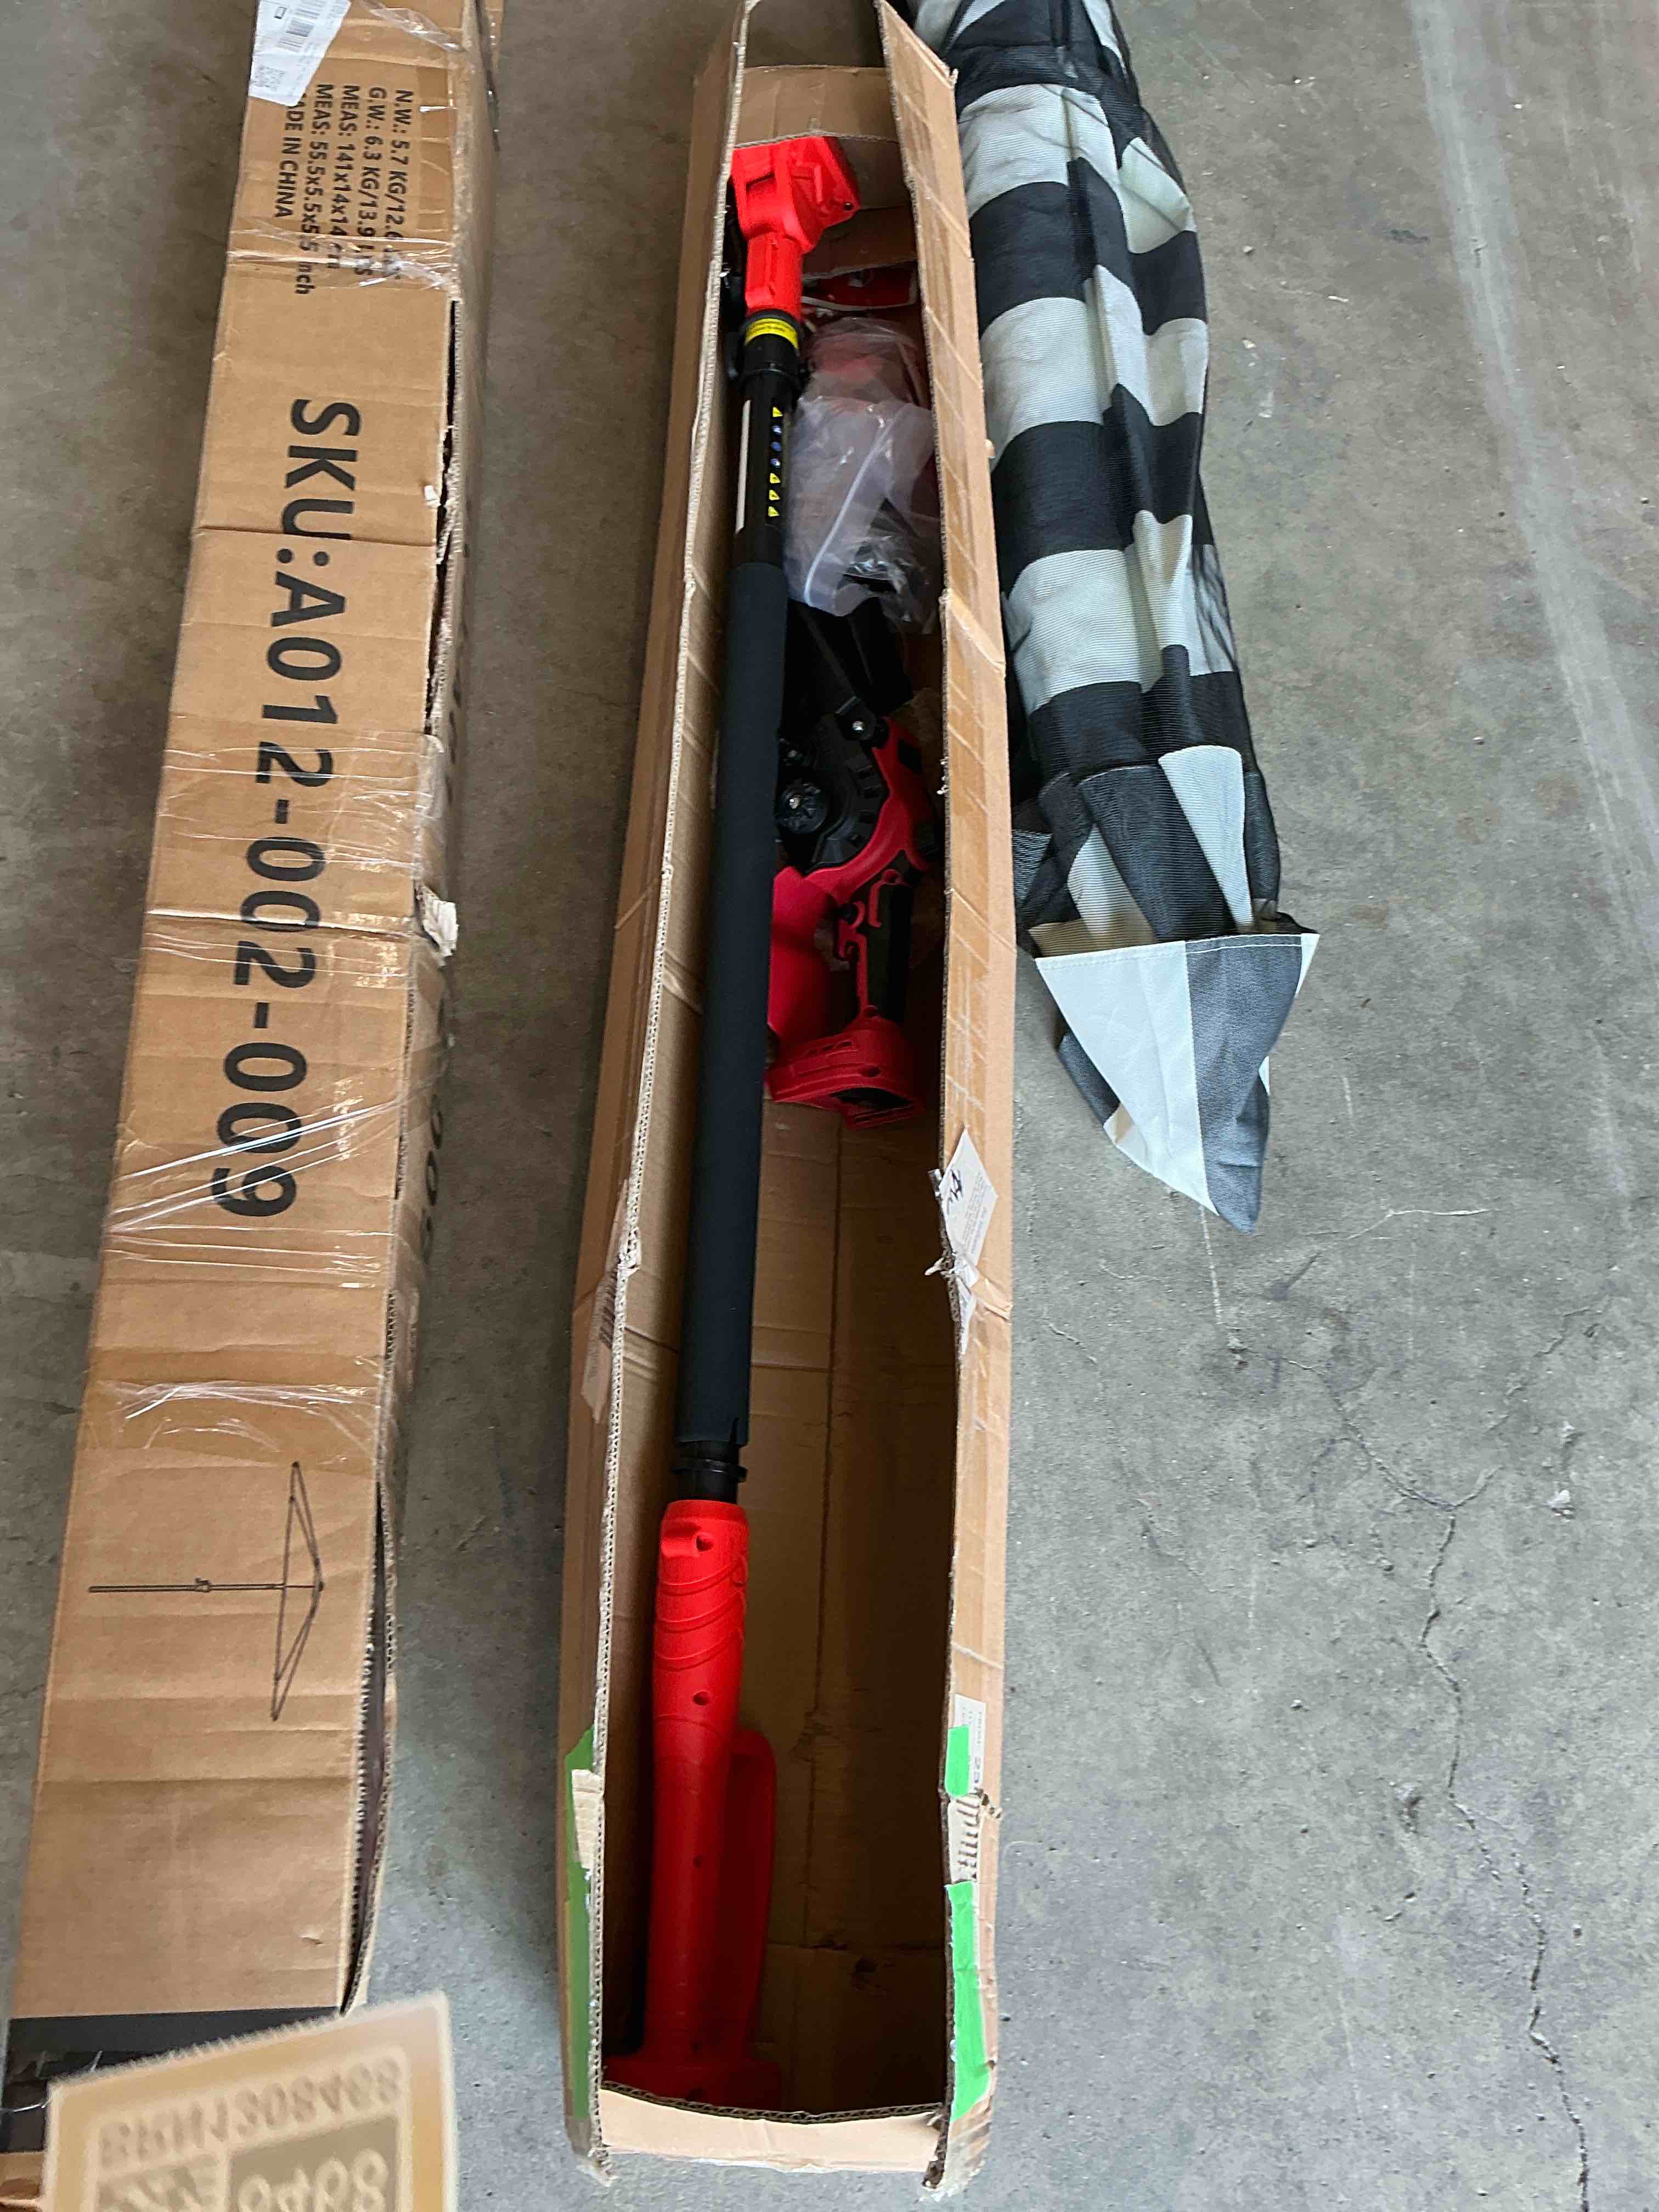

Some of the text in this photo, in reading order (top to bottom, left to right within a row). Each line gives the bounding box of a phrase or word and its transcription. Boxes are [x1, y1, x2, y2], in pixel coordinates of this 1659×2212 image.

[312, 84, 334, 135] MEAS:
[338, 86, 360, 136] MEAS:
[366, 88, 387, 129] G.W.:
[394, 90, 414, 133] N.W.:
[274, 93, 306, 218] ADE IN CHINA
[364, 136, 383, 160] 6.3
[391, 140, 410, 165] 5.7
[300, 140, 329, 253] 55.5x5.5x55
[330, 144, 356, 236] 141x14x14
[358, 167, 380, 236] KG/13.9
[211, 398, 362, 1217] SKU:A012-002-009
